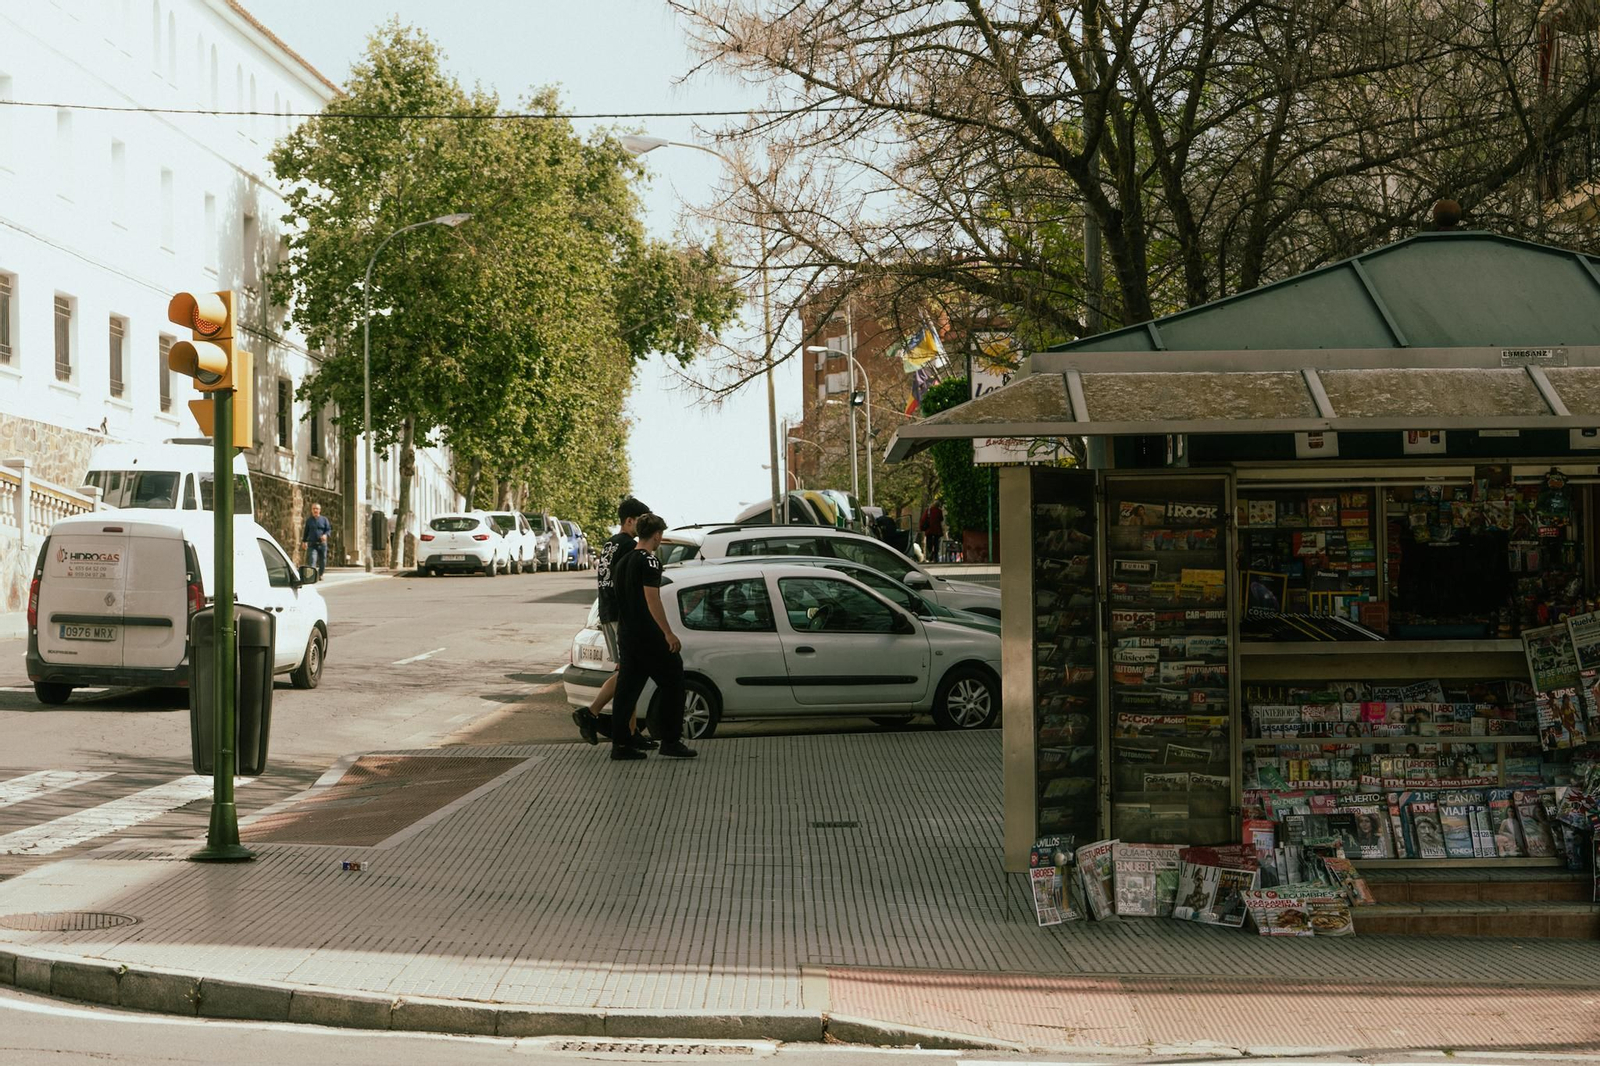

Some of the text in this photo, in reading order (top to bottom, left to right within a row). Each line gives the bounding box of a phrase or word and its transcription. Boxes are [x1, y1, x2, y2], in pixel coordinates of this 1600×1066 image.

[70, 553, 120, 562] HIDROGAS
[1186, 610, 1199, 619] CAR
[66, 627, 114, 639] 0976 MRX
[1344, 794, 1380, 803] HUERTO
[1278, 890, 1335, 899] LEGUMBRES
